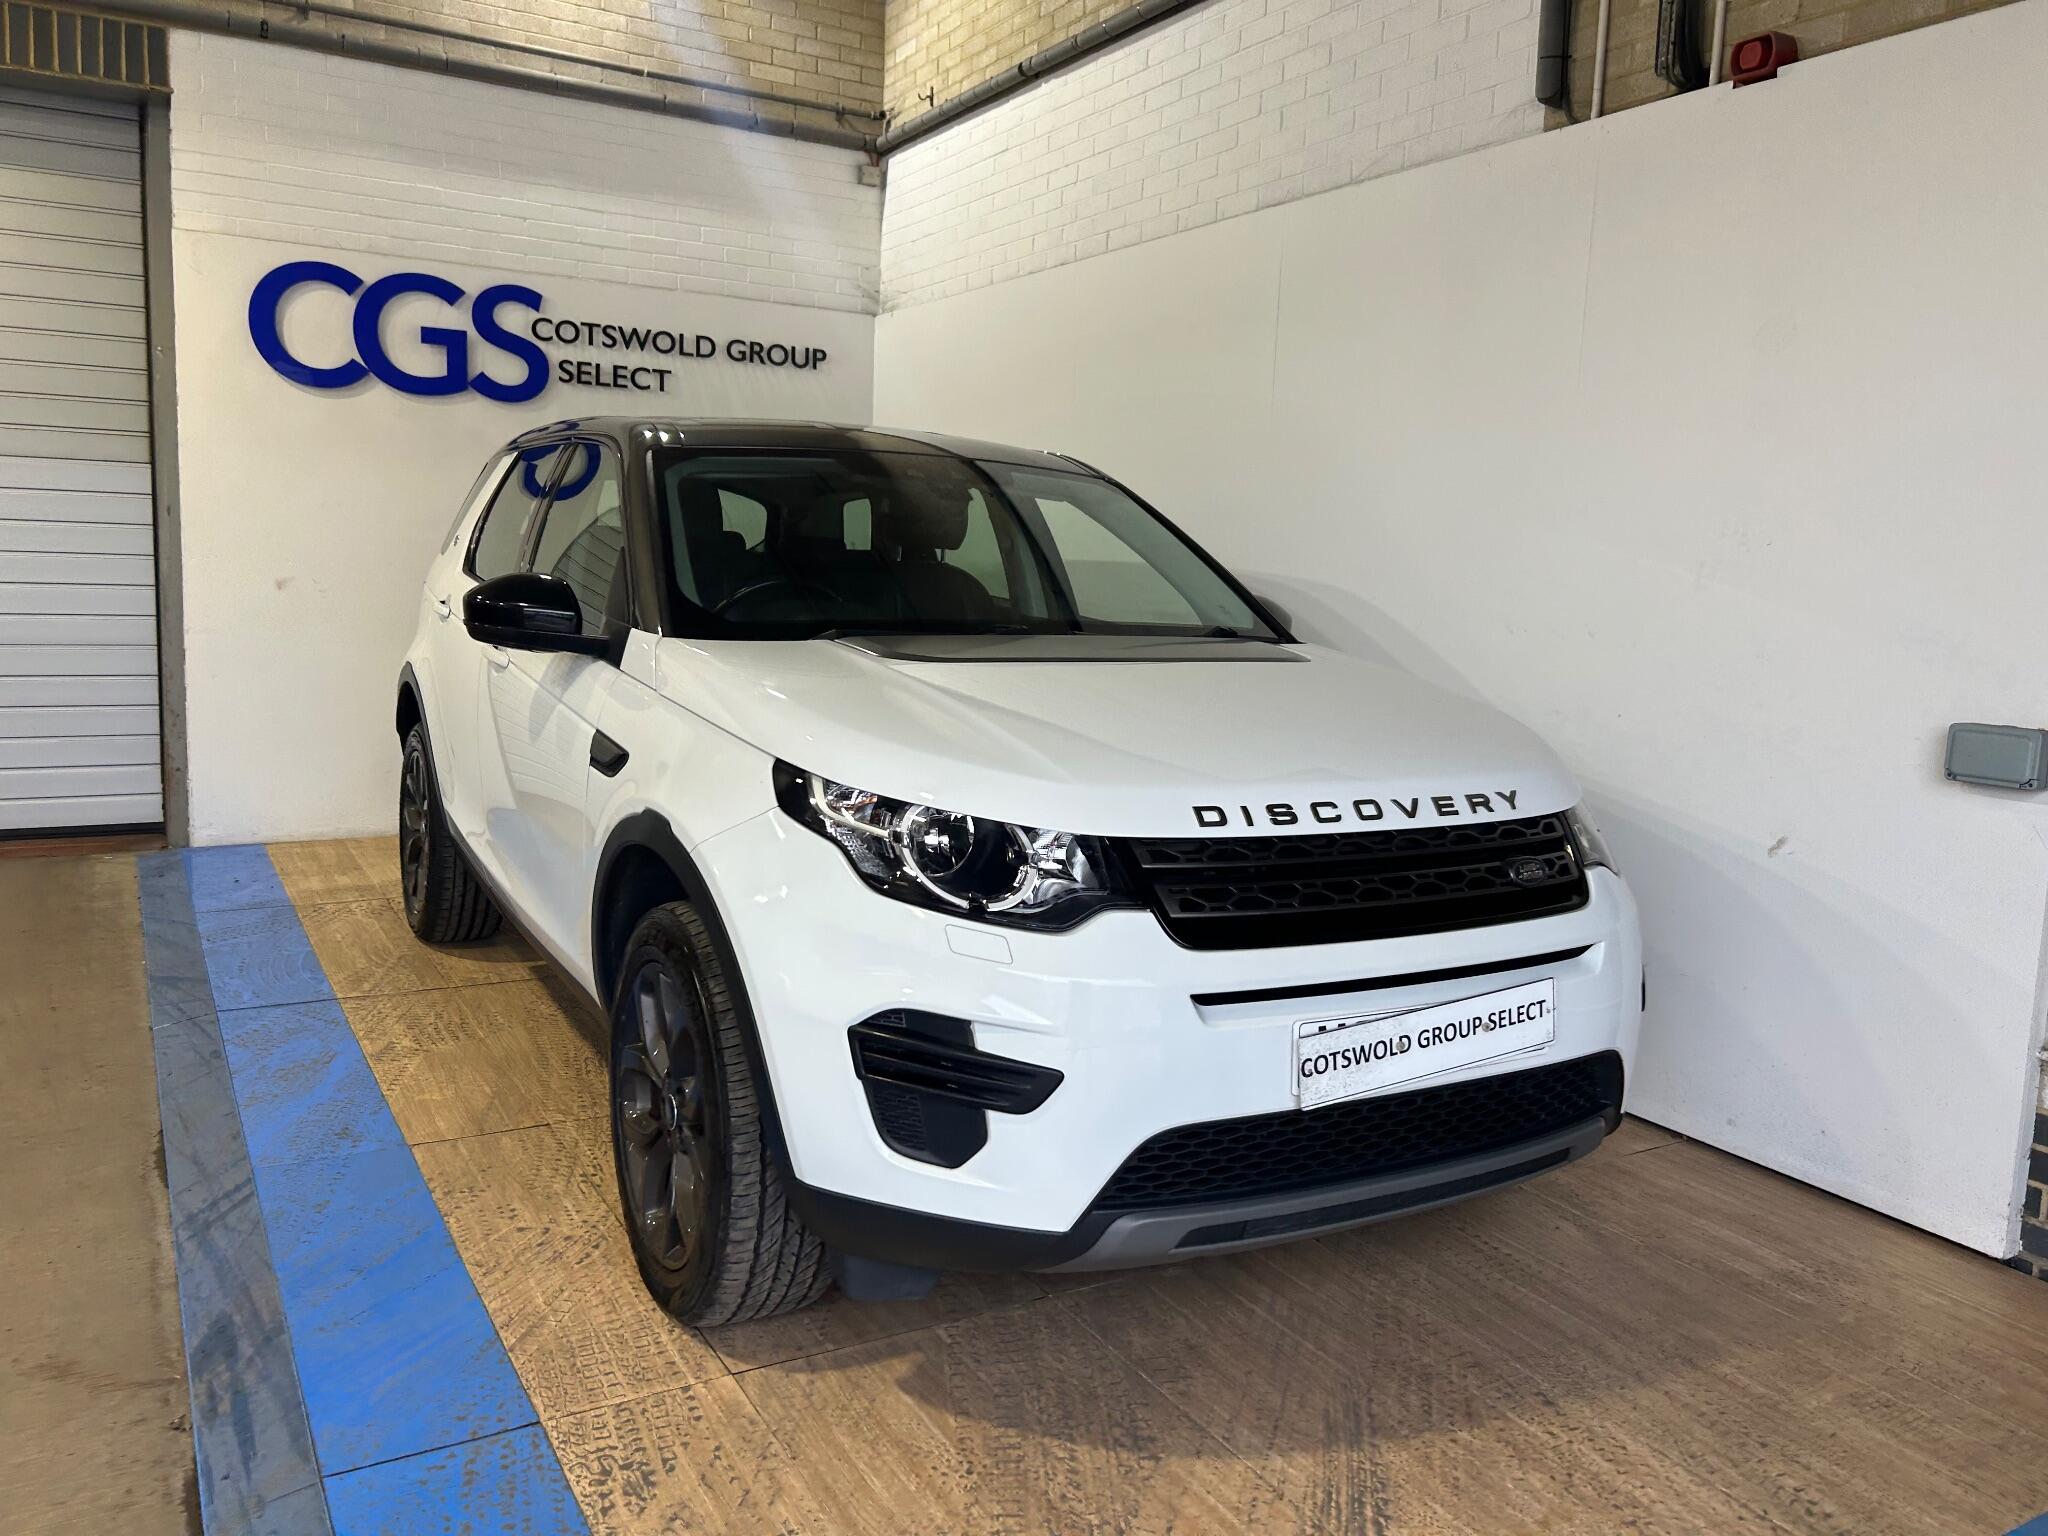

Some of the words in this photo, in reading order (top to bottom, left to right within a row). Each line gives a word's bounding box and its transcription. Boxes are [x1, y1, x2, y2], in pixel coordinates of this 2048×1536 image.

[248, 260, 550, 402] CGS
[531, 317, 717, 359] COTSWOLD
[726, 338, 828, 370] GROUP
[558, 359, 672, 393] SELECT
[1192, 790, 1518, 828] DISCOVERY
[1300, 1035, 1412, 1078] COTSWOLD
[1417, 1016, 1482, 1049] GROUP
[1487, 1000, 1547, 1032] SELECT
